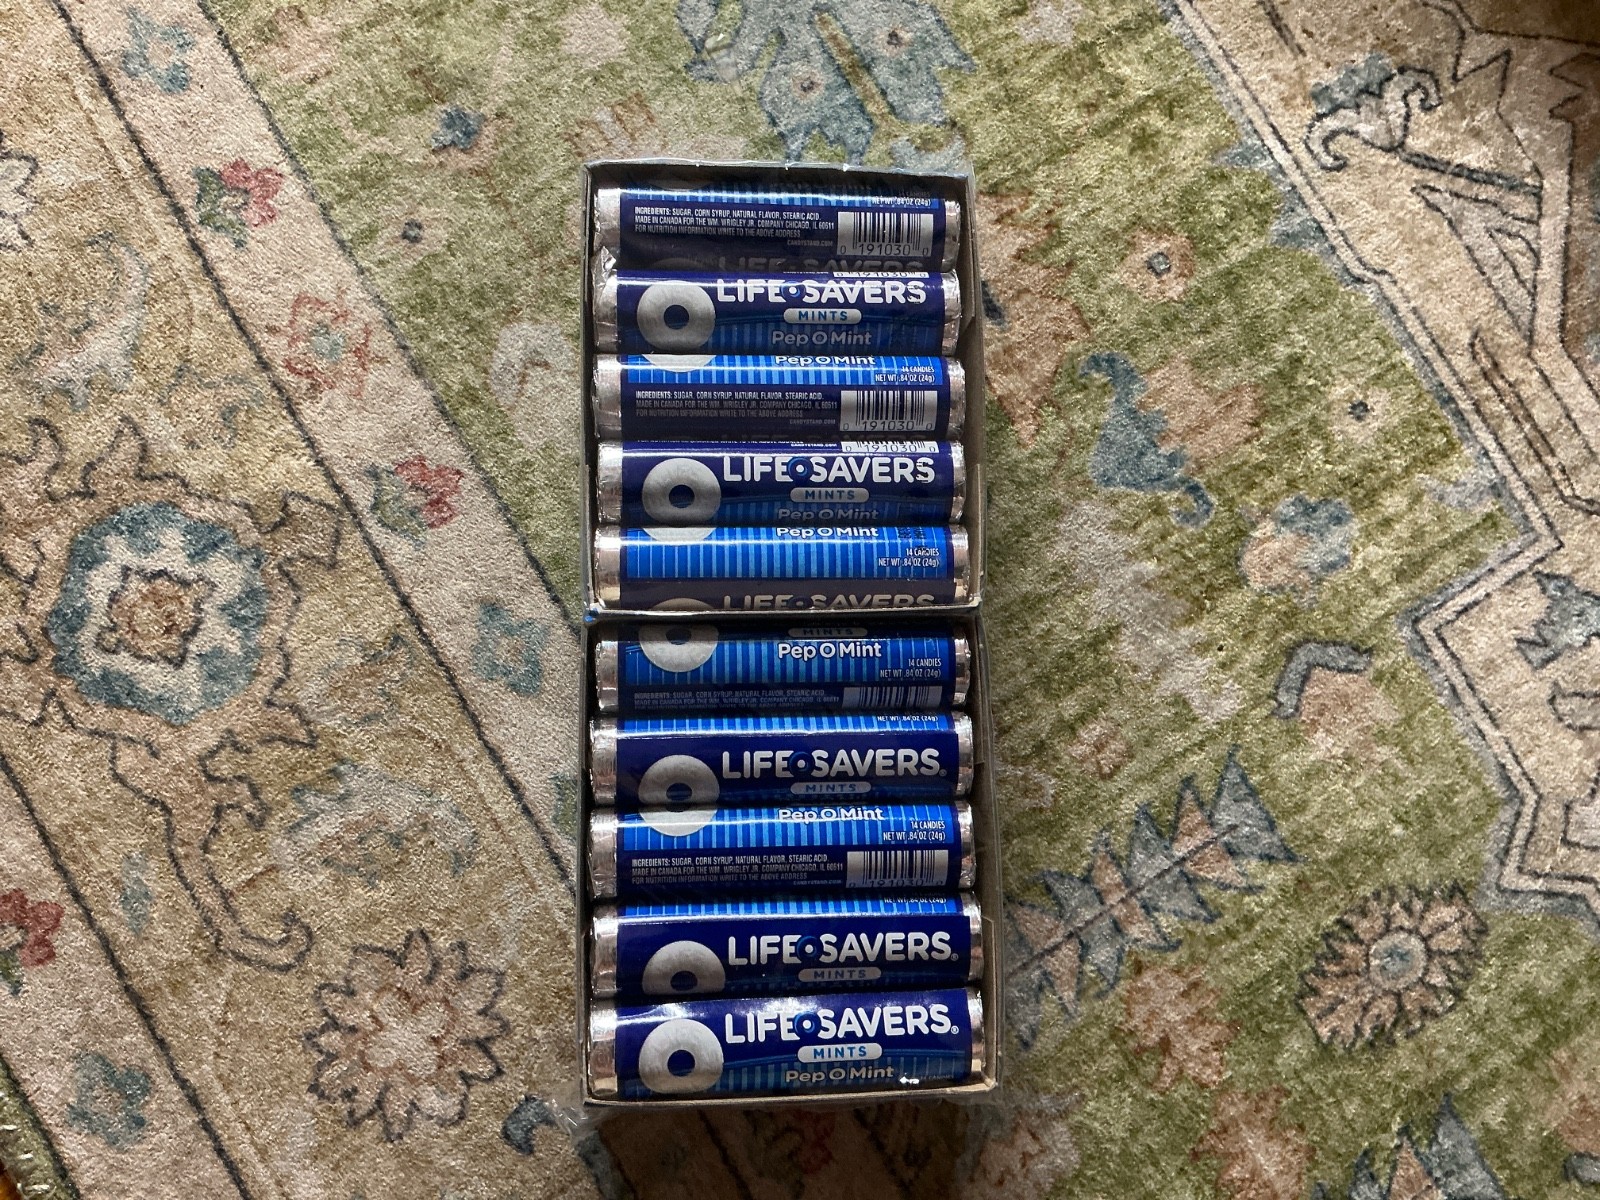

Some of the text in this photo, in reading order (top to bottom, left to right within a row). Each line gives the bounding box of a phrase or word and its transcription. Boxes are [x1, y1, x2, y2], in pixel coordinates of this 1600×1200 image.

[635, 206, 821, 220] INGREDIENTS: SUGAR, CORN SYRUP, NATURAL FLAVOR, STEARIC ACID.
[840, 246, 846, 254] 0
[858, 244, 910, 255] 191030
[718, 279, 927, 304] LIFE SAVERS
[798, 310, 848, 321] MINTS
[772, 331, 872, 347] Pep O Mint
[776, 356, 876, 366] Pep O Mint
[875, 374, 936, 383] NET WT .84 OZ (24g)
[842, 422, 849, 431] 0
[862, 420, 914, 431] 191030
[926, 422, 932, 431] 0
[864, 444, 917, 452] 191030
[724, 457, 936, 483] LIFE SAVERS
[805, 490, 855, 500] MINTS
[778, 508, 814, 520] Pep
[838, 508, 879, 519] Mint
[776, 527, 879, 539] Pep O Mint
[906, 548, 912, 556] 14
[878, 557, 940, 568] NET WT .84 OZ (24g)
[778, 642, 882, 661] Pep O Mint
[908, 658, 941, 667] 14 CANDIES
[880, 669, 942, 678] NET WT .84 OZ (24g)
[722, 751, 794, 778] LIFE
[806, 784, 856, 792] MINTS
[778, 808, 885, 824] Pep O Mint
[911, 821, 946, 830] 14 CANDIES
[883, 831, 946, 840] NET WT .84 OZ (24g)
[728, 935, 802, 965] LIFE
[814, 970, 866, 980] MINTS
[725, 1011, 800, 1044] LIFE
[814, 1046, 867, 1060] MINTS
[786, 1066, 894, 1083] Pep O Mint
